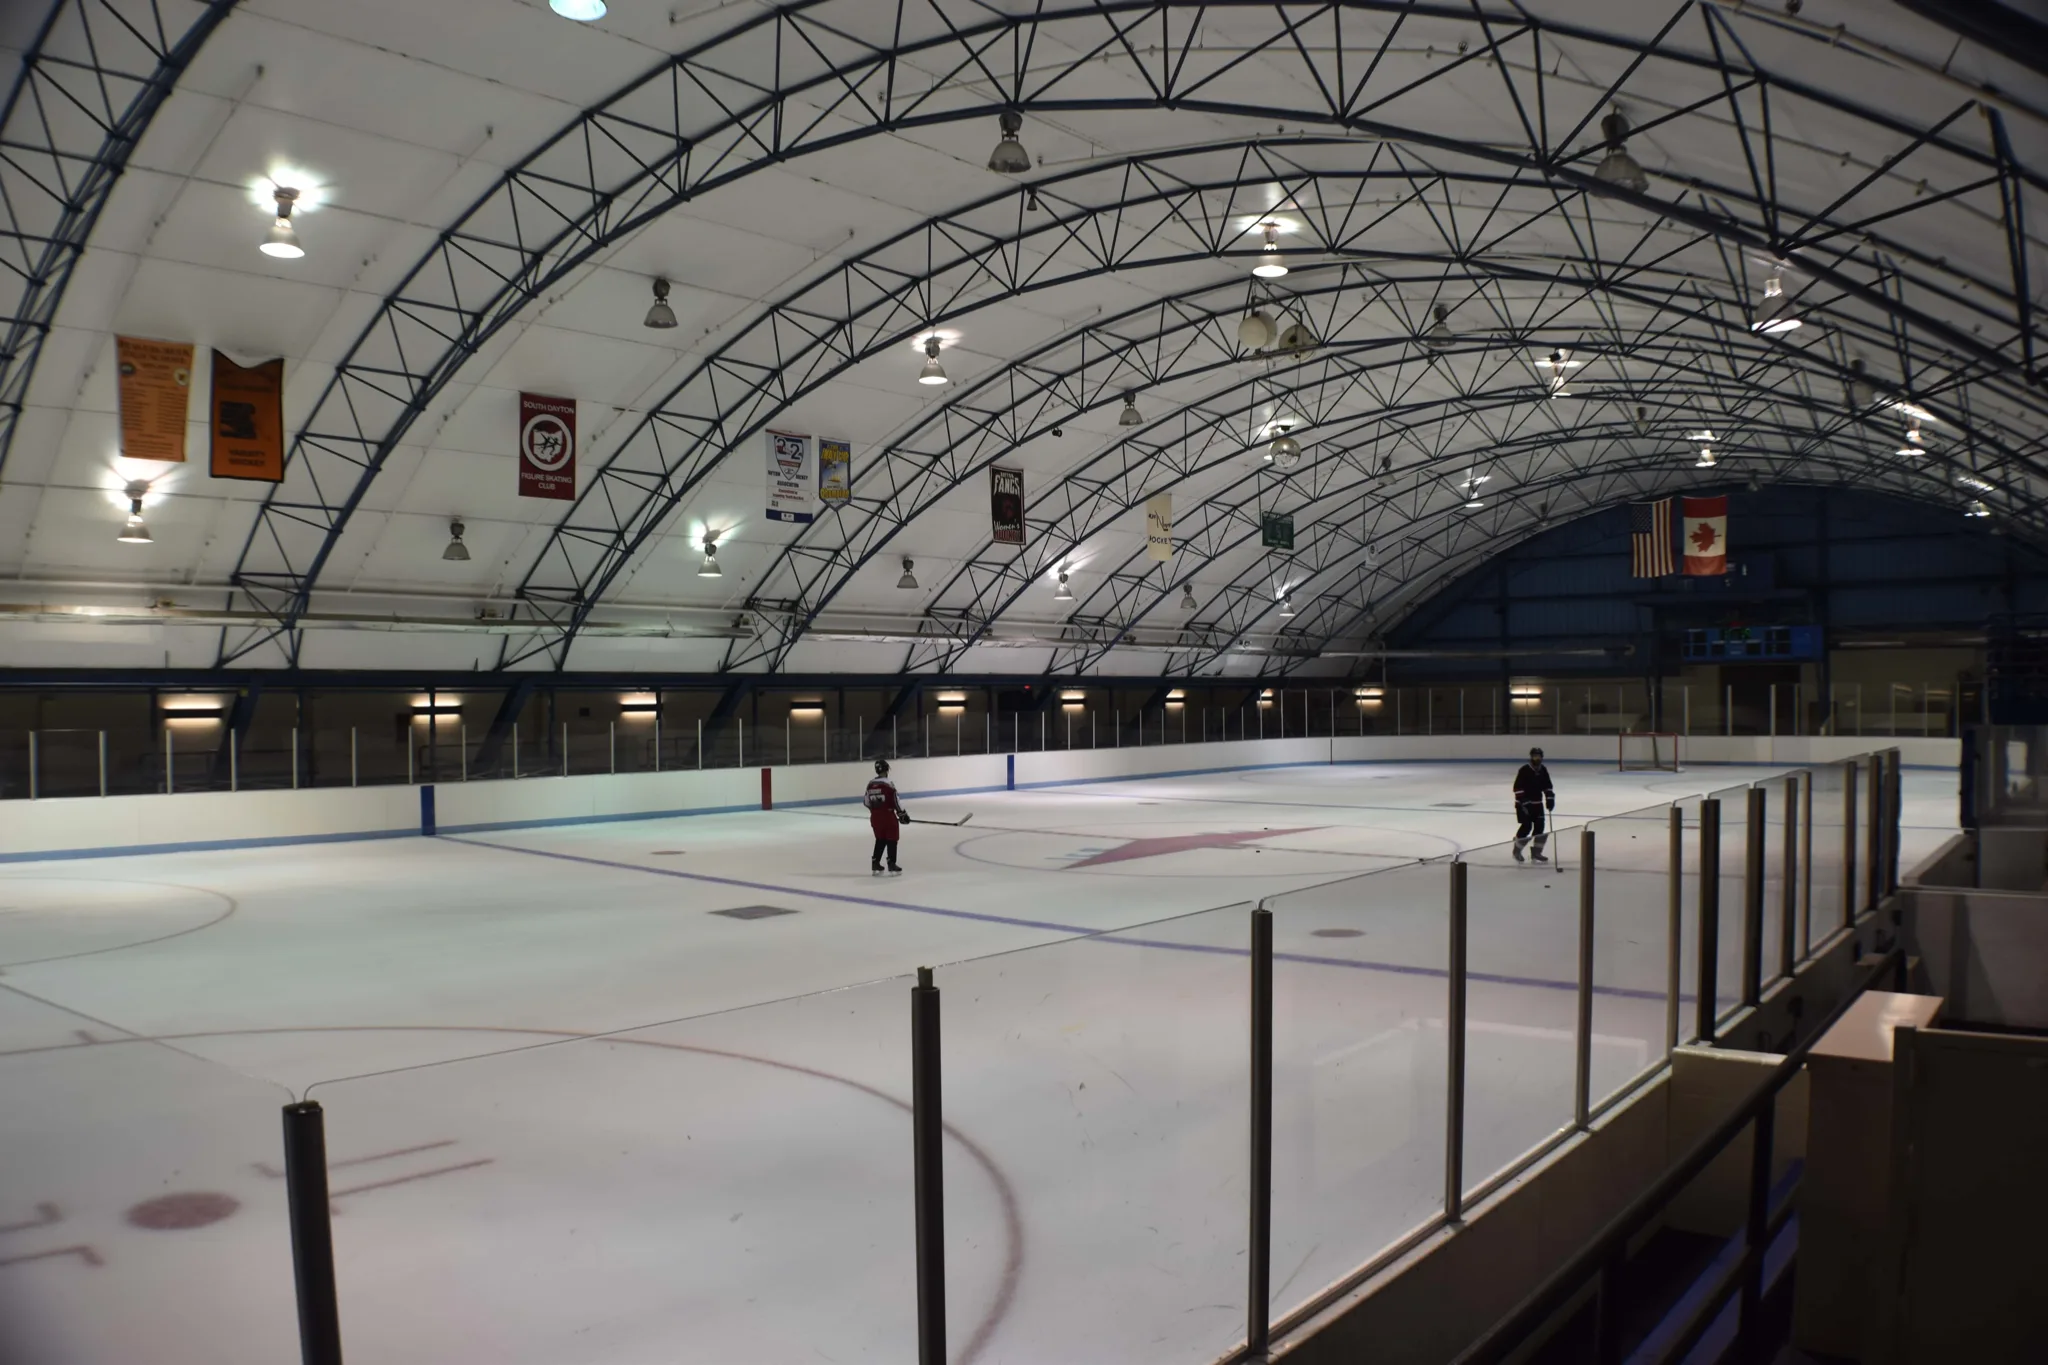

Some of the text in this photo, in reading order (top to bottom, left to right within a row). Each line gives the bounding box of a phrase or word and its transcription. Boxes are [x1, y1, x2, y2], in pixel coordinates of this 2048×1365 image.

[523, 400, 575, 414] SOUTH DAYTON
[790, 443, 801, 460] 2
[521, 472, 573, 484] FIGURE SKATING
[538, 482, 557, 490] CLUB
[993, 474, 1021, 500] FANGS
